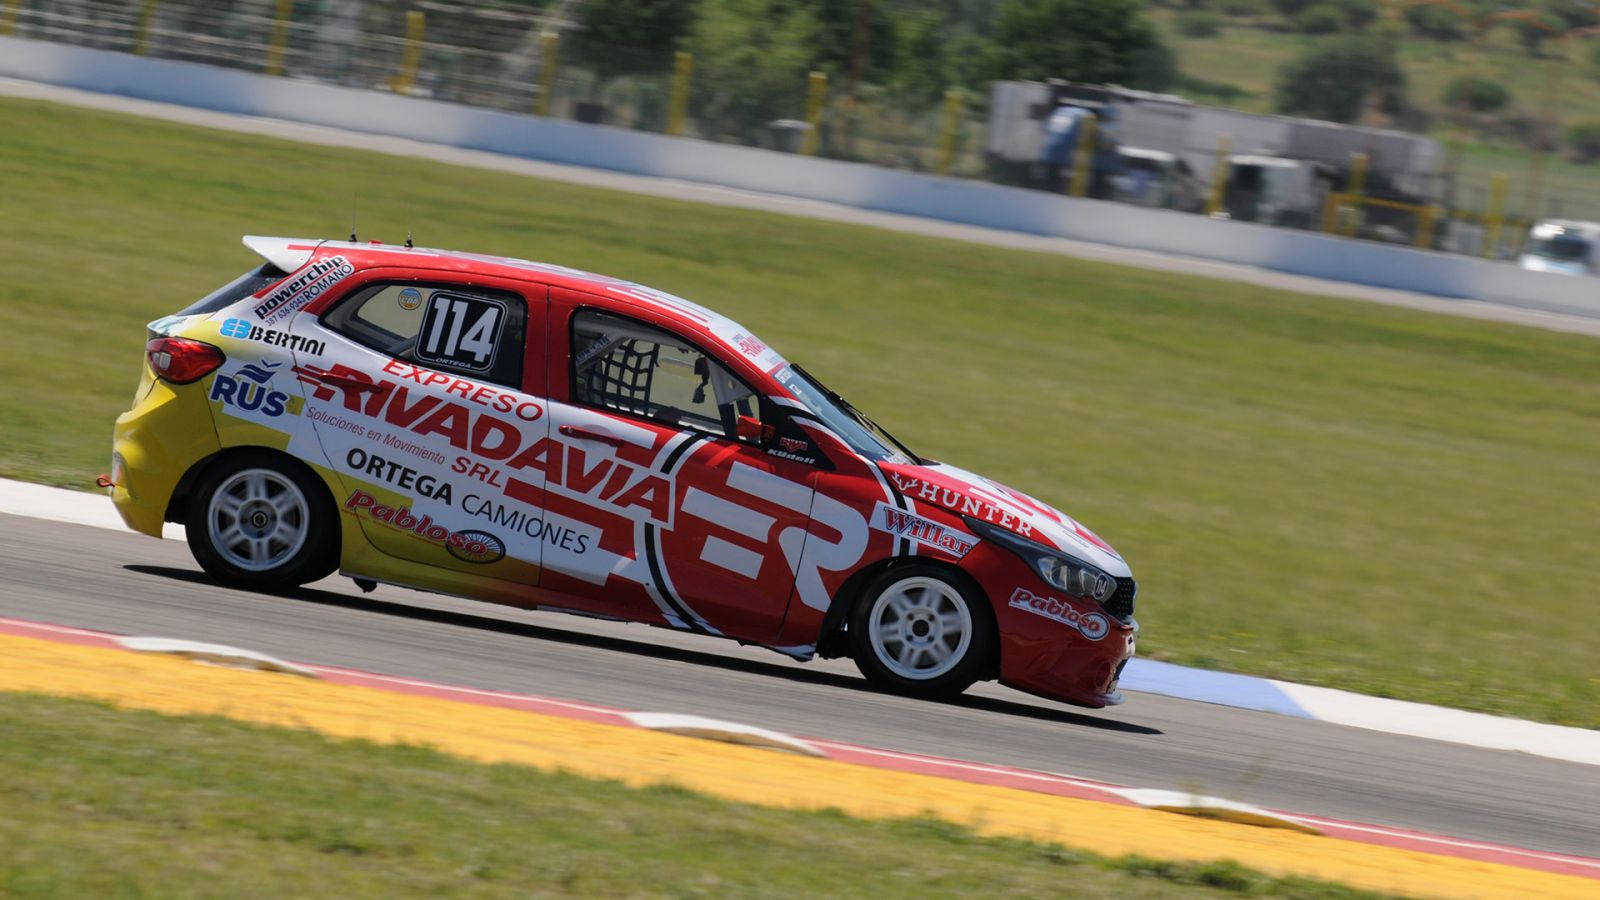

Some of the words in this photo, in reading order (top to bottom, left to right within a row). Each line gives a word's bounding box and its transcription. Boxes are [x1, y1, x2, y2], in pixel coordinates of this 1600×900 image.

[255, 257, 343, 319] powerchip
[302, 264, 352, 301] ROMANO
[249, 325, 326, 356] BERTINI
[426, 297, 499, 362] 114
[382, 358, 543, 421] EXPRESO
[435, 358, 471, 368] ORTEGA
[305, 406, 366, 436] Soluciones
[366, 429, 382, 441] en
[383, 433, 446, 465] Movimiento
[312, 363, 670, 524] RIVADAVIA
[451, 456, 501, 488] SRL
[345, 489, 488, 555] Pabloso
[346, 447, 452, 506] ORTEGA
[461, 494, 590, 555] CAMIONES
[918, 481, 1033, 537] HUNTER
[883, 506, 971, 555] Willar
[1010, 588, 1100, 632] Pabloso
